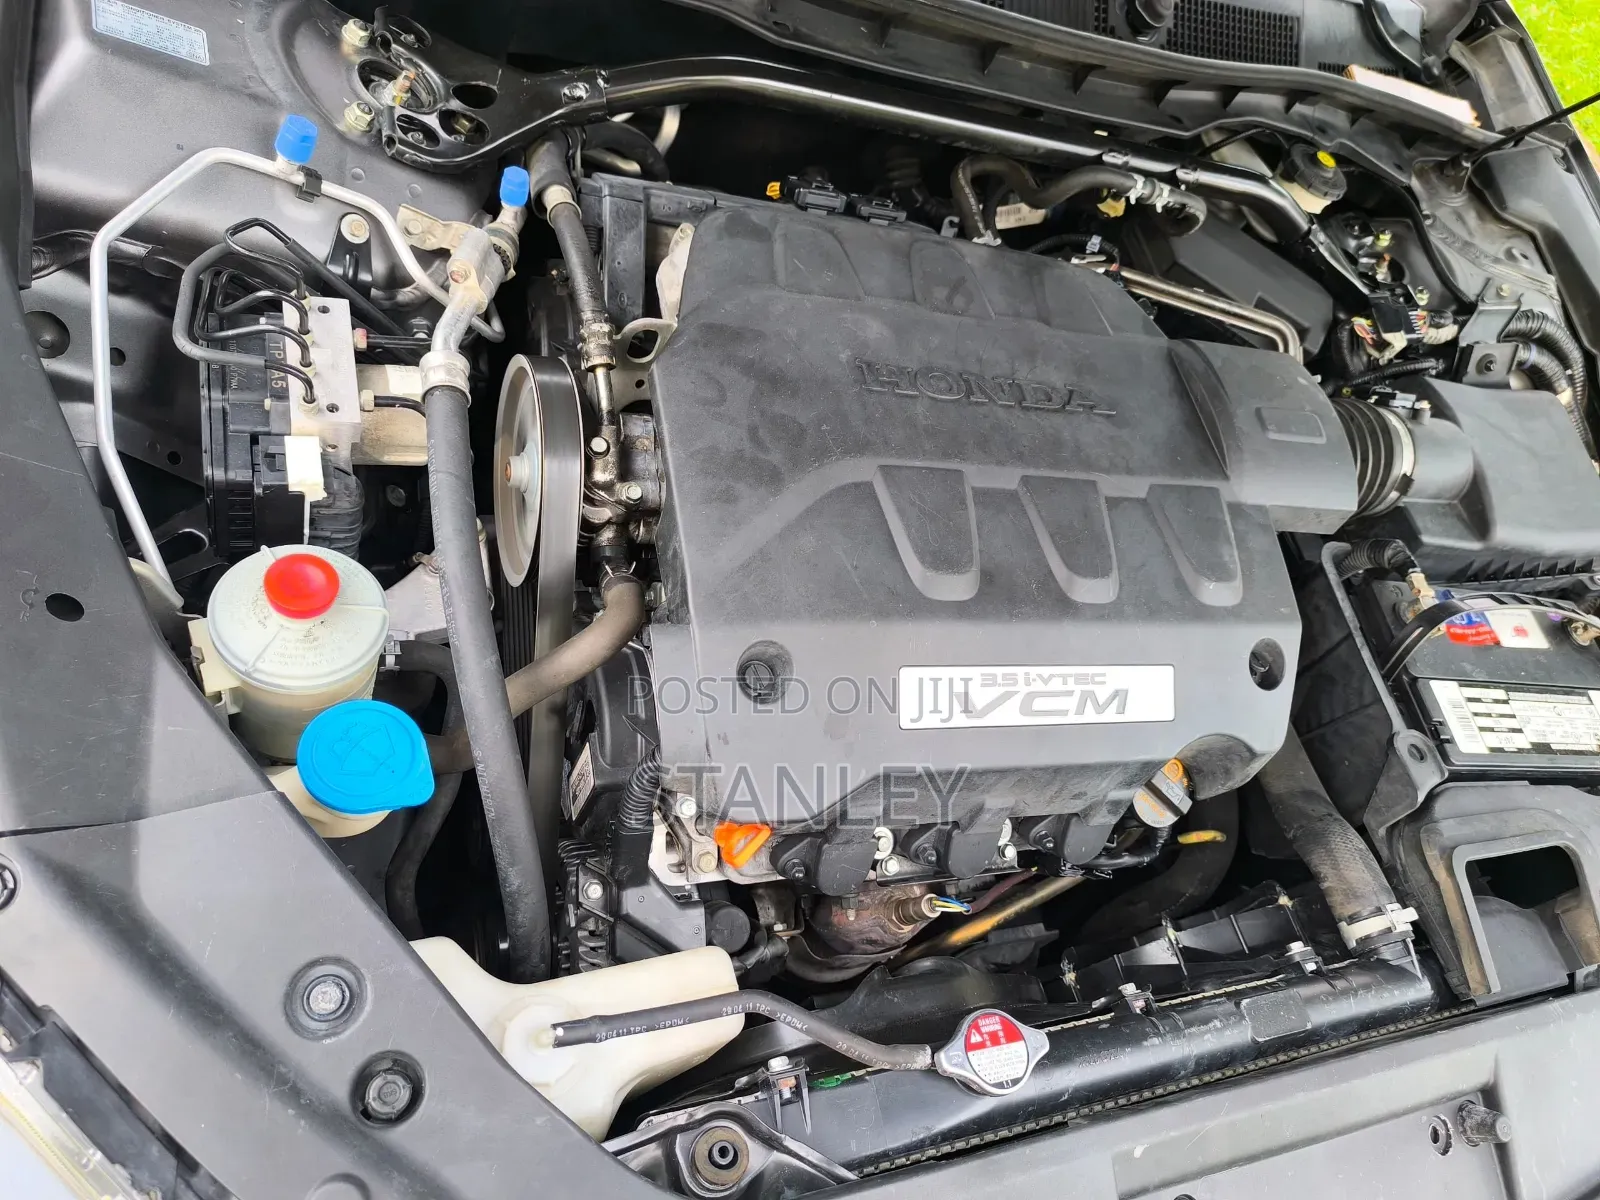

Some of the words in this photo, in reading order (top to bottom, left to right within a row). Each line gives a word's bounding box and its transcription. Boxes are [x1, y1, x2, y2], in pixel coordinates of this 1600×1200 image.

[269, 341, 286, 388] TPA5
[855, 357, 1117, 415] HONDA
[980, 672, 1019, 688] 3.5
[1023, 671, 1107, 687] i-VTEC
[953, 687, 1129, 720] VCM
